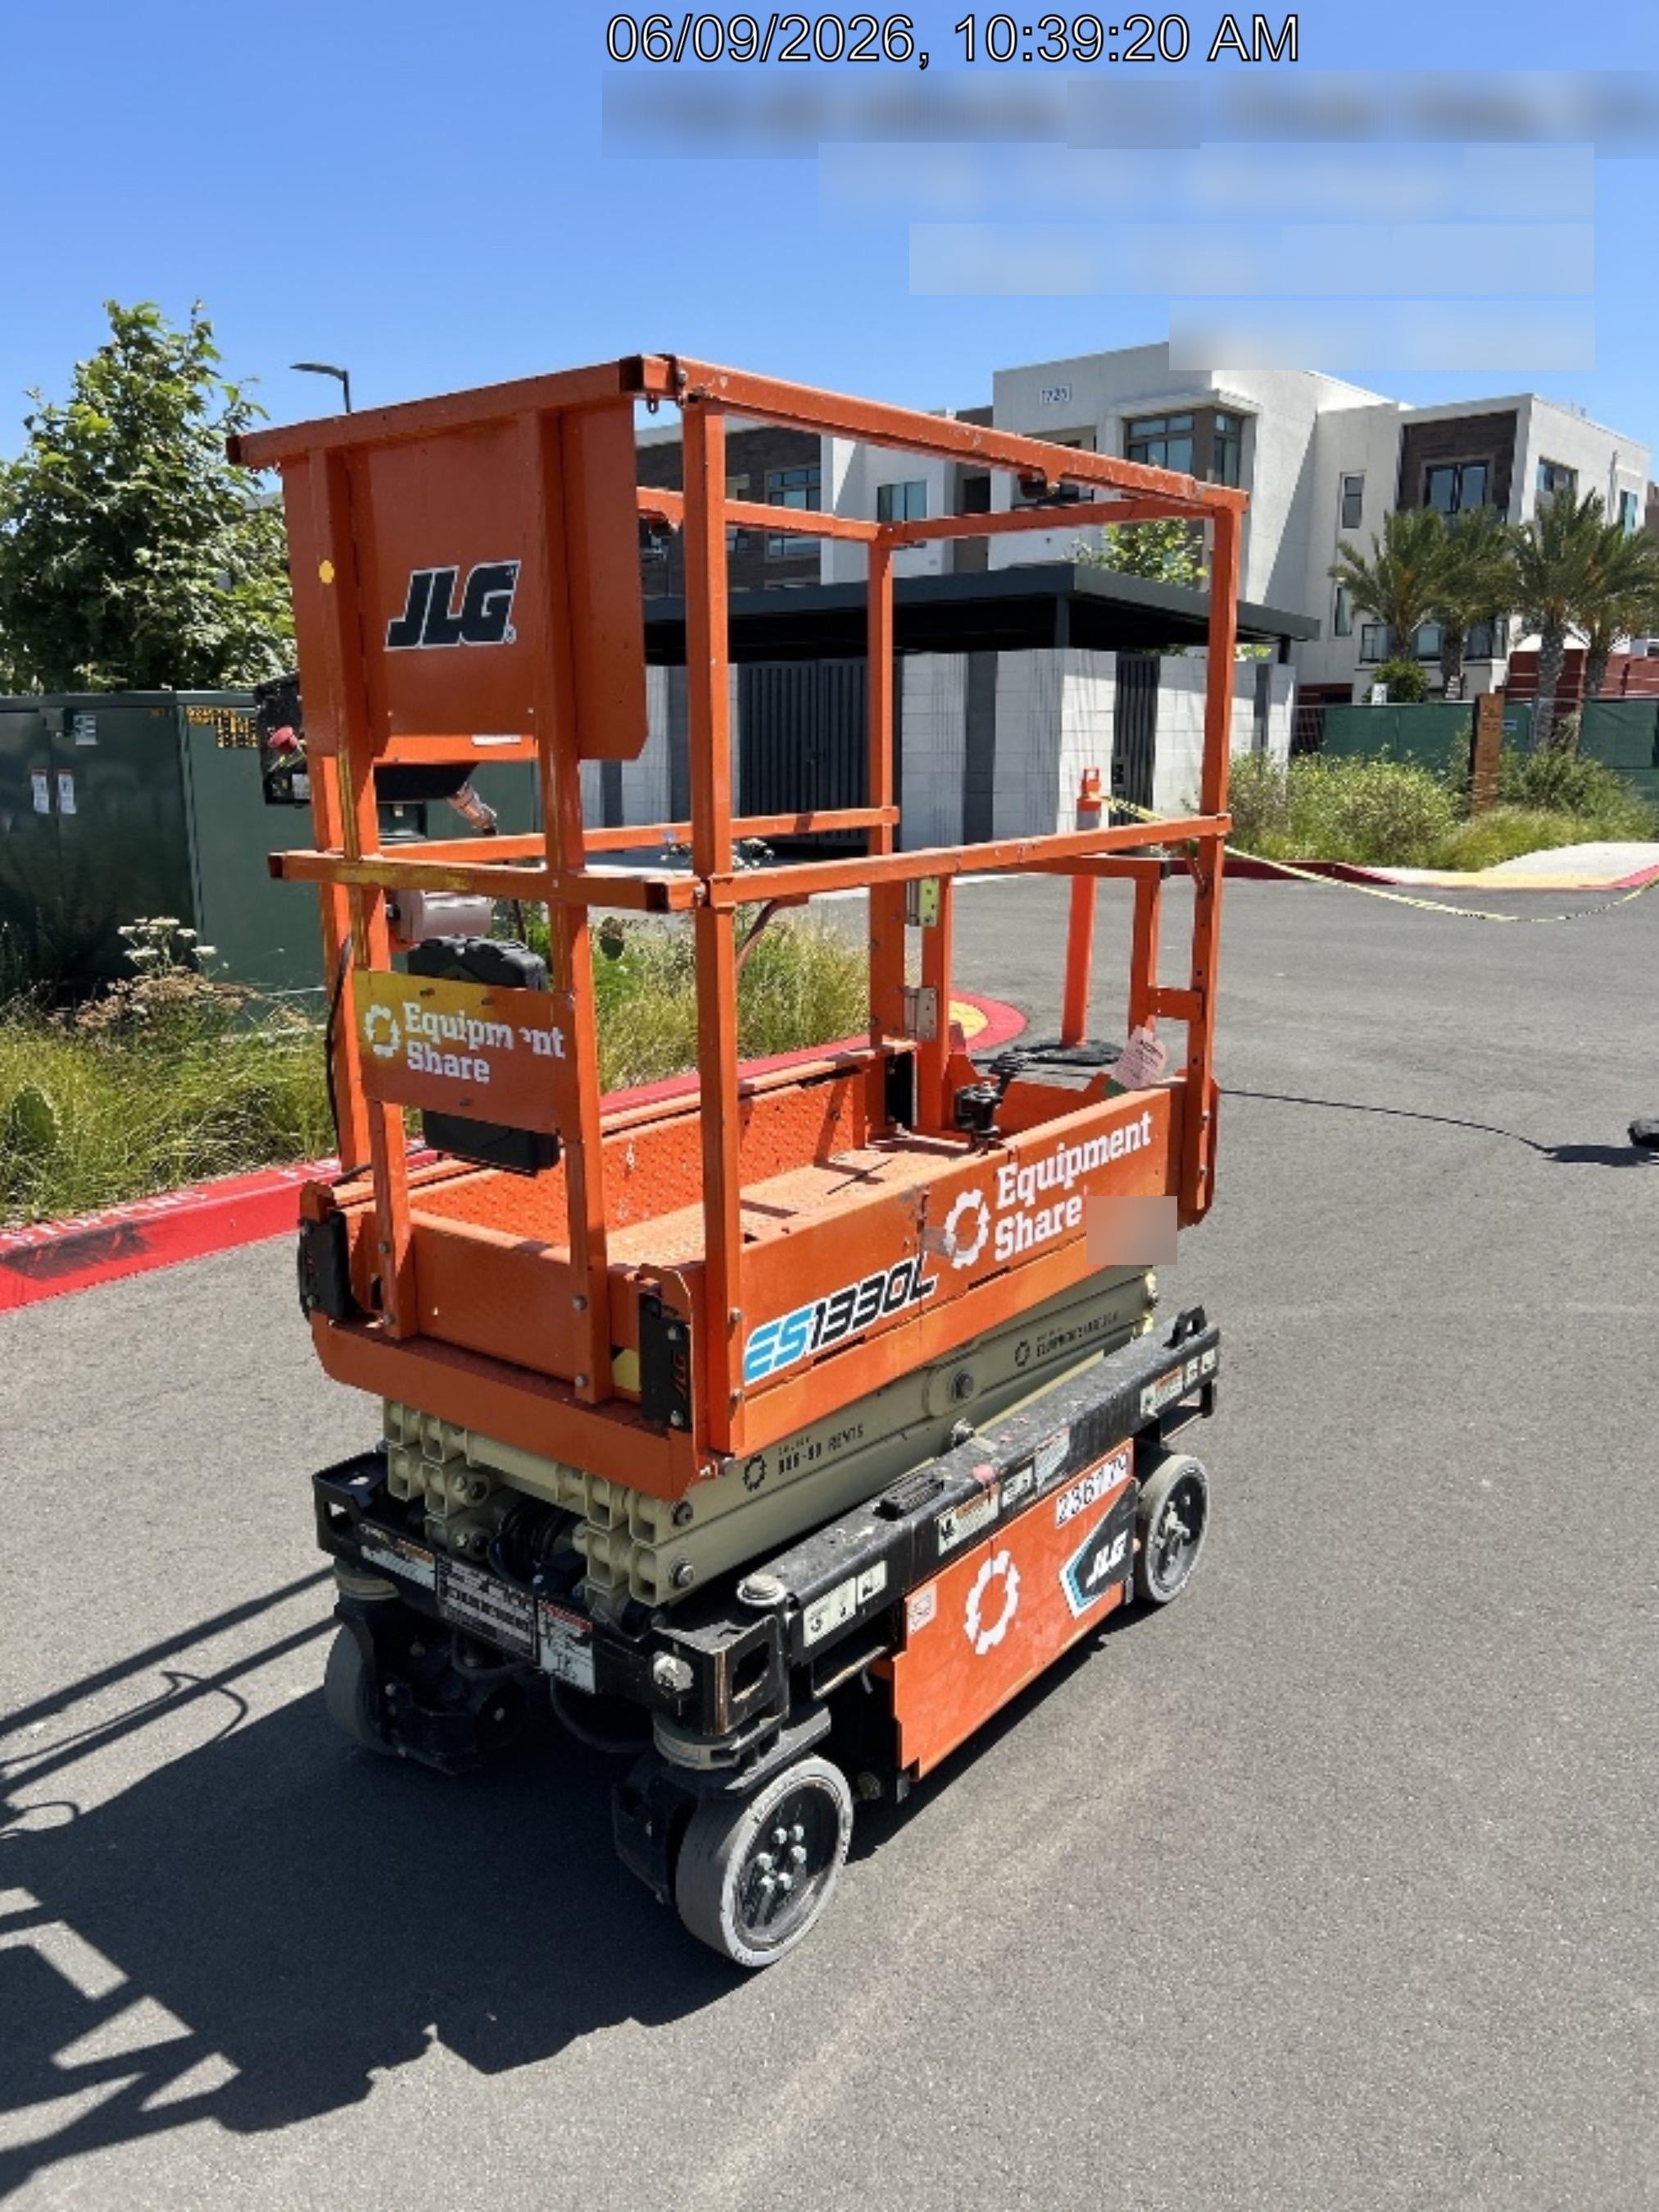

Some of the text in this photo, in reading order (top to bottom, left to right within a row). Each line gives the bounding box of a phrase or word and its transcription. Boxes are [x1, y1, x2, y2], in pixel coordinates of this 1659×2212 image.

[383, 560, 521, 650] JLG
[406, 1040, 490, 1084] Share
[996, 1110, 1152, 1209] Equipment
[995, 1194, 1082, 1262] Share
[743, 1251, 939, 1386] ES1330L
[1086, 1529, 1129, 1589] JLG
